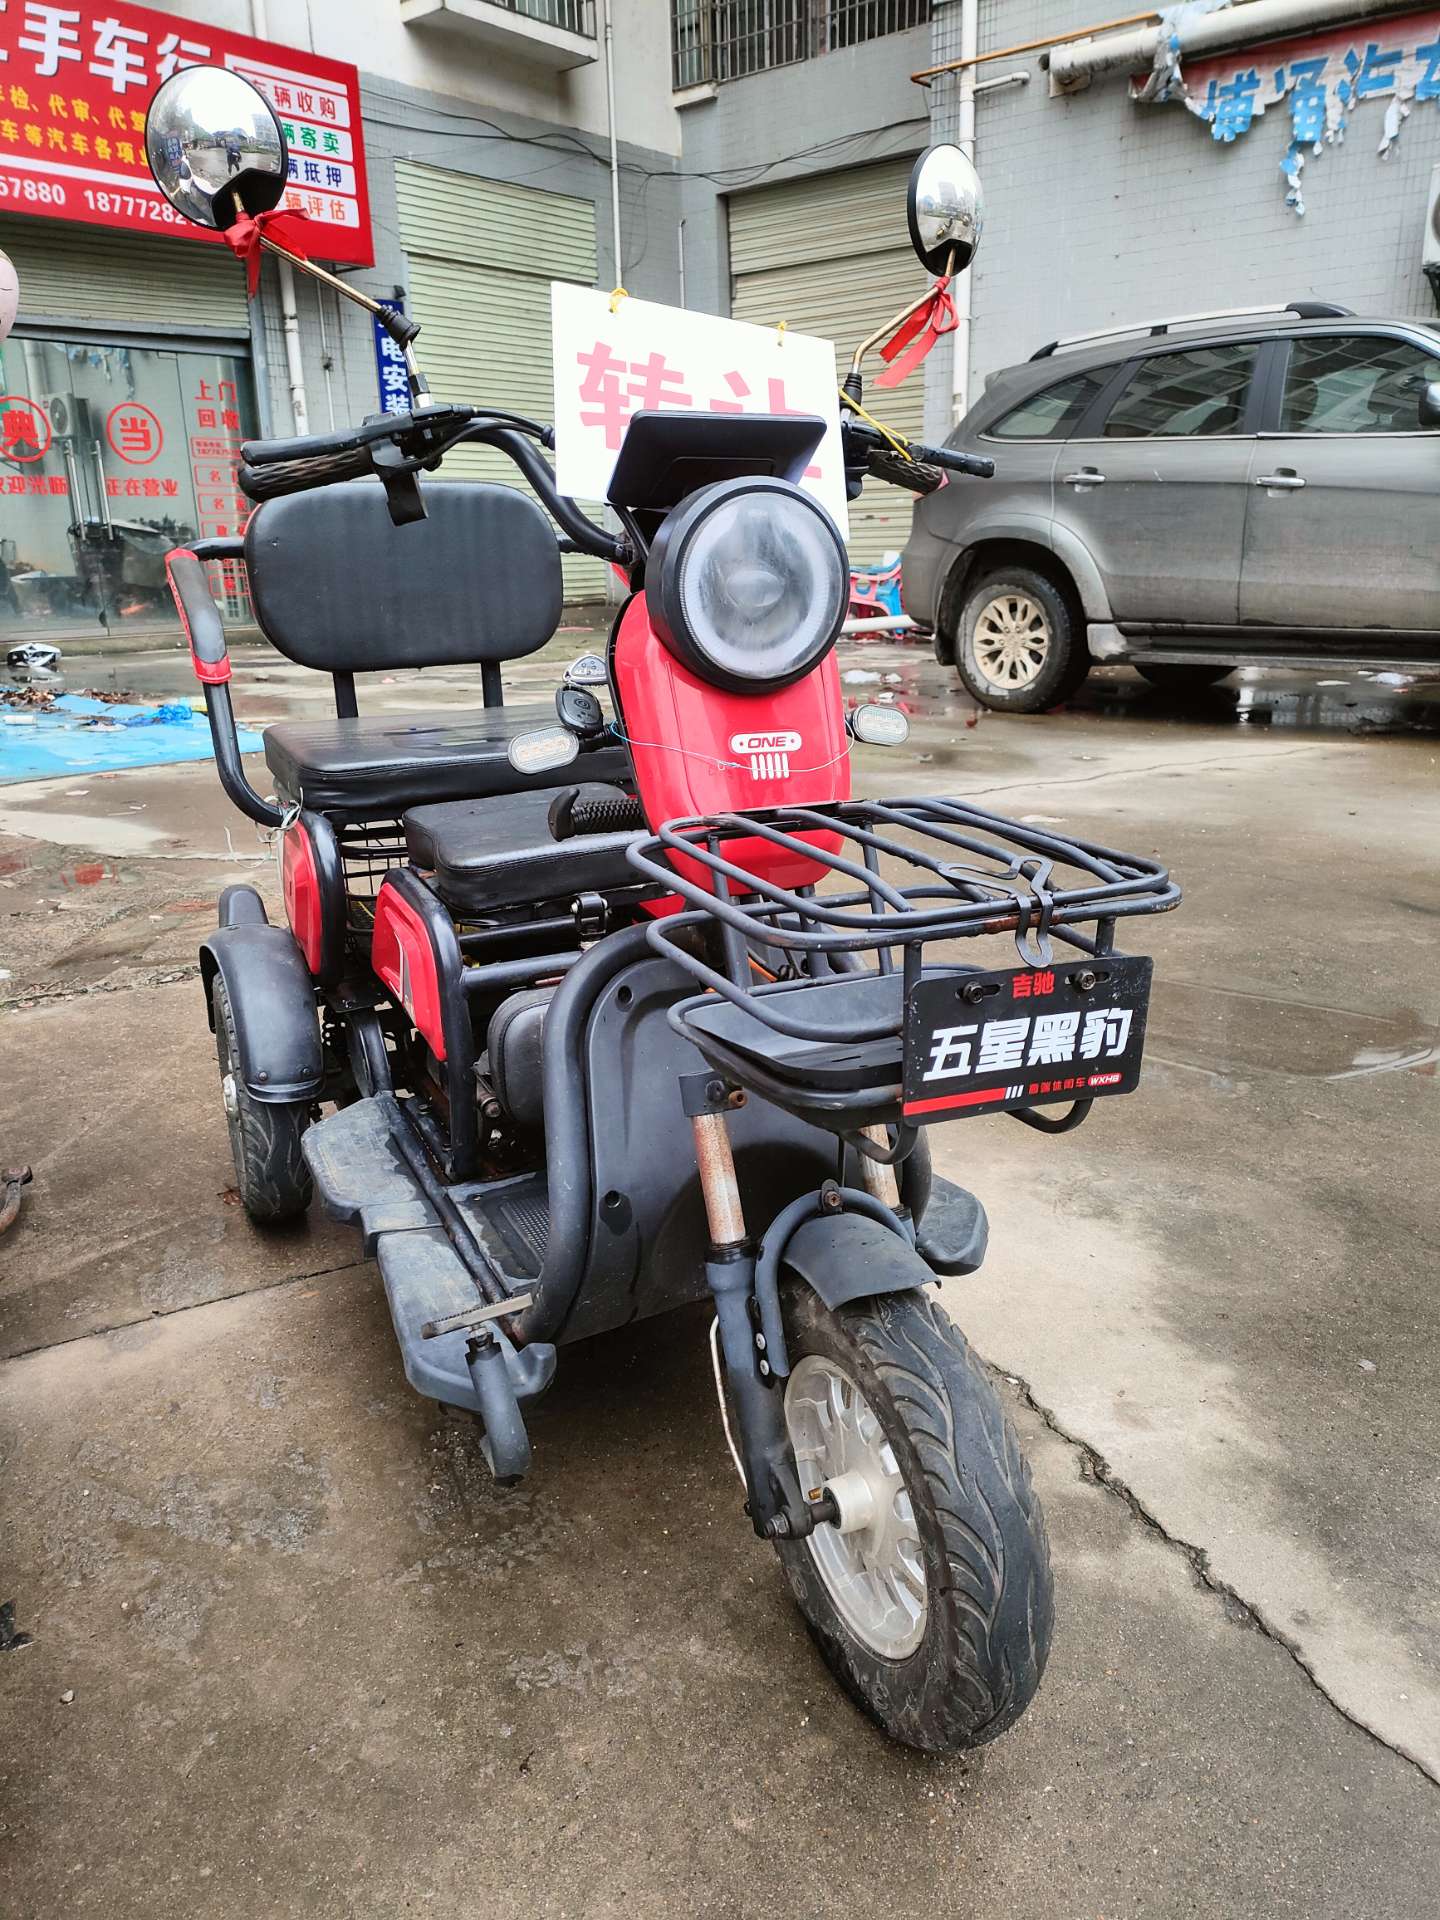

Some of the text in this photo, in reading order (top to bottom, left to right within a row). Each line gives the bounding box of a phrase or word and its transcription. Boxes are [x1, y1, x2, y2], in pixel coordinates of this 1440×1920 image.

[0, 0, 212, 95] 手车行
[84, 189, 198, 227] 18777282
[378, 304, 411, 416] 电安装
[194, 378, 237, 402] 上门
[120, 416, 152, 452] 当
[106, 477, 180, 498] 正在营业
[747, 736, 787, 749] ONE
[1012, 971, 1055, 999] 吉驰
[922, 1007, 1134, 1082] 五星黑豹
[1089, 1073, 1121, 1087] WXHB
